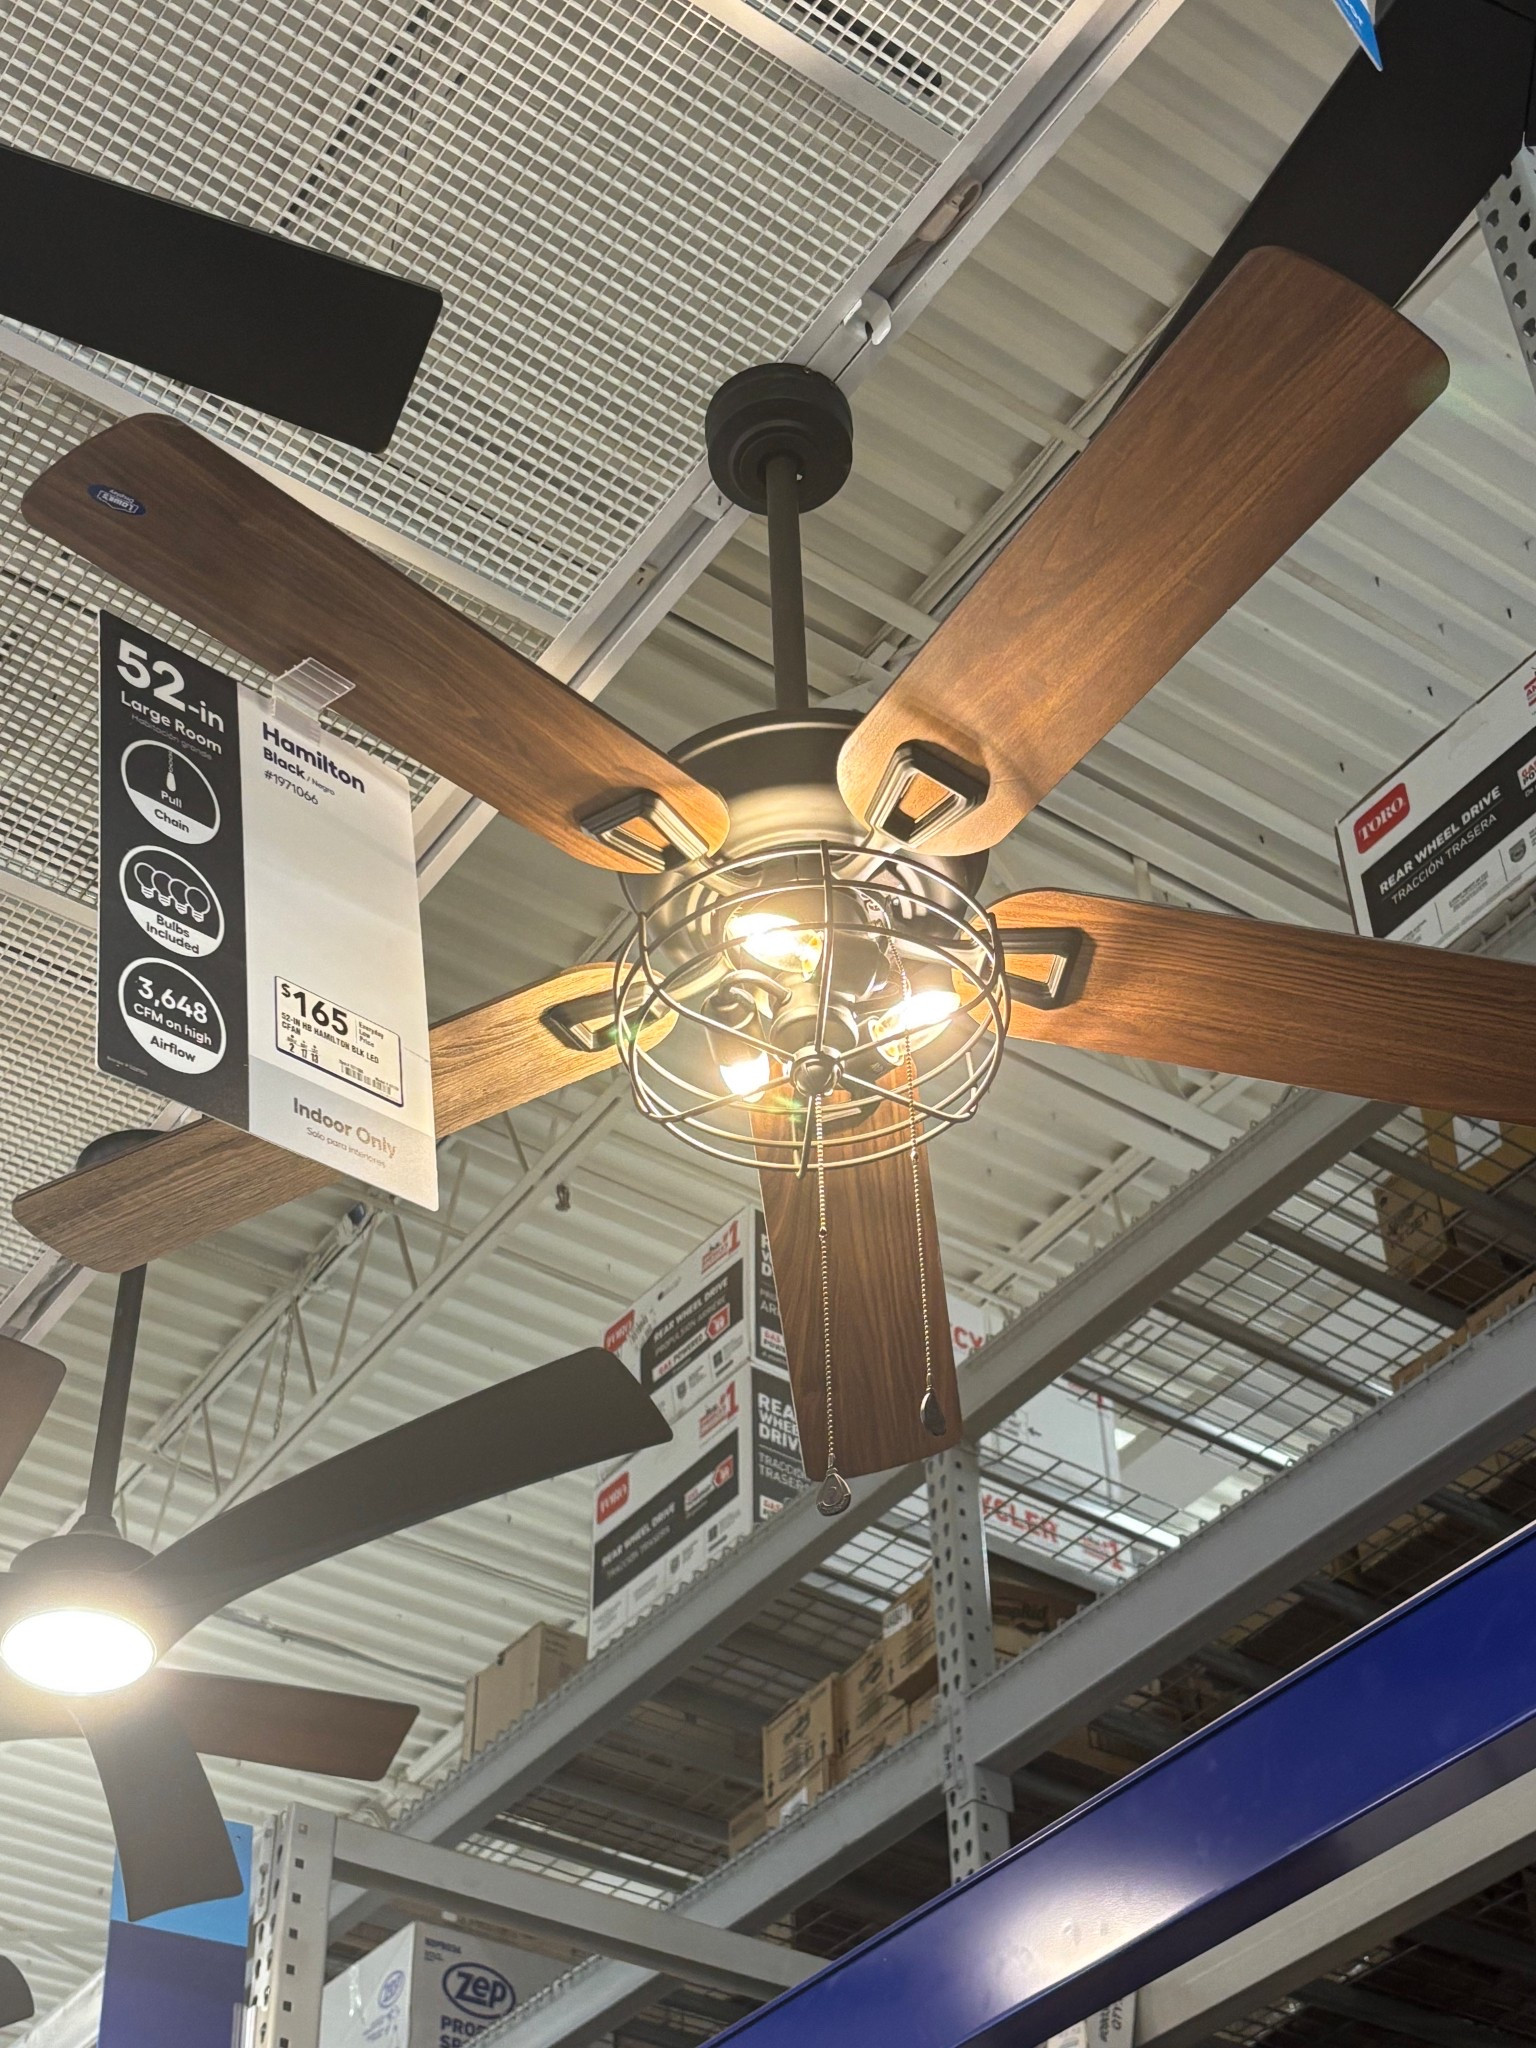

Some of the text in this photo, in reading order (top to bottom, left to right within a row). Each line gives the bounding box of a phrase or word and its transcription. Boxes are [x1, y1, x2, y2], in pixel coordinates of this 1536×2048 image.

[116, 638, 224, 733] 52-in
[121, 690, 222, 754] Large Room
[262, 721, 365, 794] Hamilton
[263, 747, 306, 780] Black
[161, 790, 182, 808] Pull
[264, 769, 319, 805] #1971066
[154, 808, 190, 833] Chain
[1359, 796, 1404, 841] TORO
[1379, 860, 1413, 895] REAR
[1414, 823, 1460, 864] WHEEL
[1461, 785, 1502, 826] DRIVE
[1391, 856, 1444, 905] TRACCIÓN
[1445, 813, 1497, 860] TRASERA
[146, 921, 199, 954] Included
[156, 914, 190, 938] Bulbs
[138, 975, 208, 1024] 3,648
[281, 983, 349, 1036] $165
[133, 1003, 212, 1046] CFM on high
[281, 1021, 301, 1036] CFAN
[281, 1012, 301, 1027] 52-IN
[302, 1022, 312, 1033] HB
[314, 1027, 350, 1051] HAMILTON
[351, 1045, 365, 1058] BLK
[366, 1052, 380, 1065] LED
[358, 1021, 384, 1040] Everyday
[149, 1035, 196, 1062] Airflow
[293, 1097, 397, 1159] Indoor Only
[327, 1137, 347, 1151] para
[758, 1392, 795, 1421] REA
[759, 1410, 799, 1437] WHEE
[759, 1422, 801, 1452] DRIV
